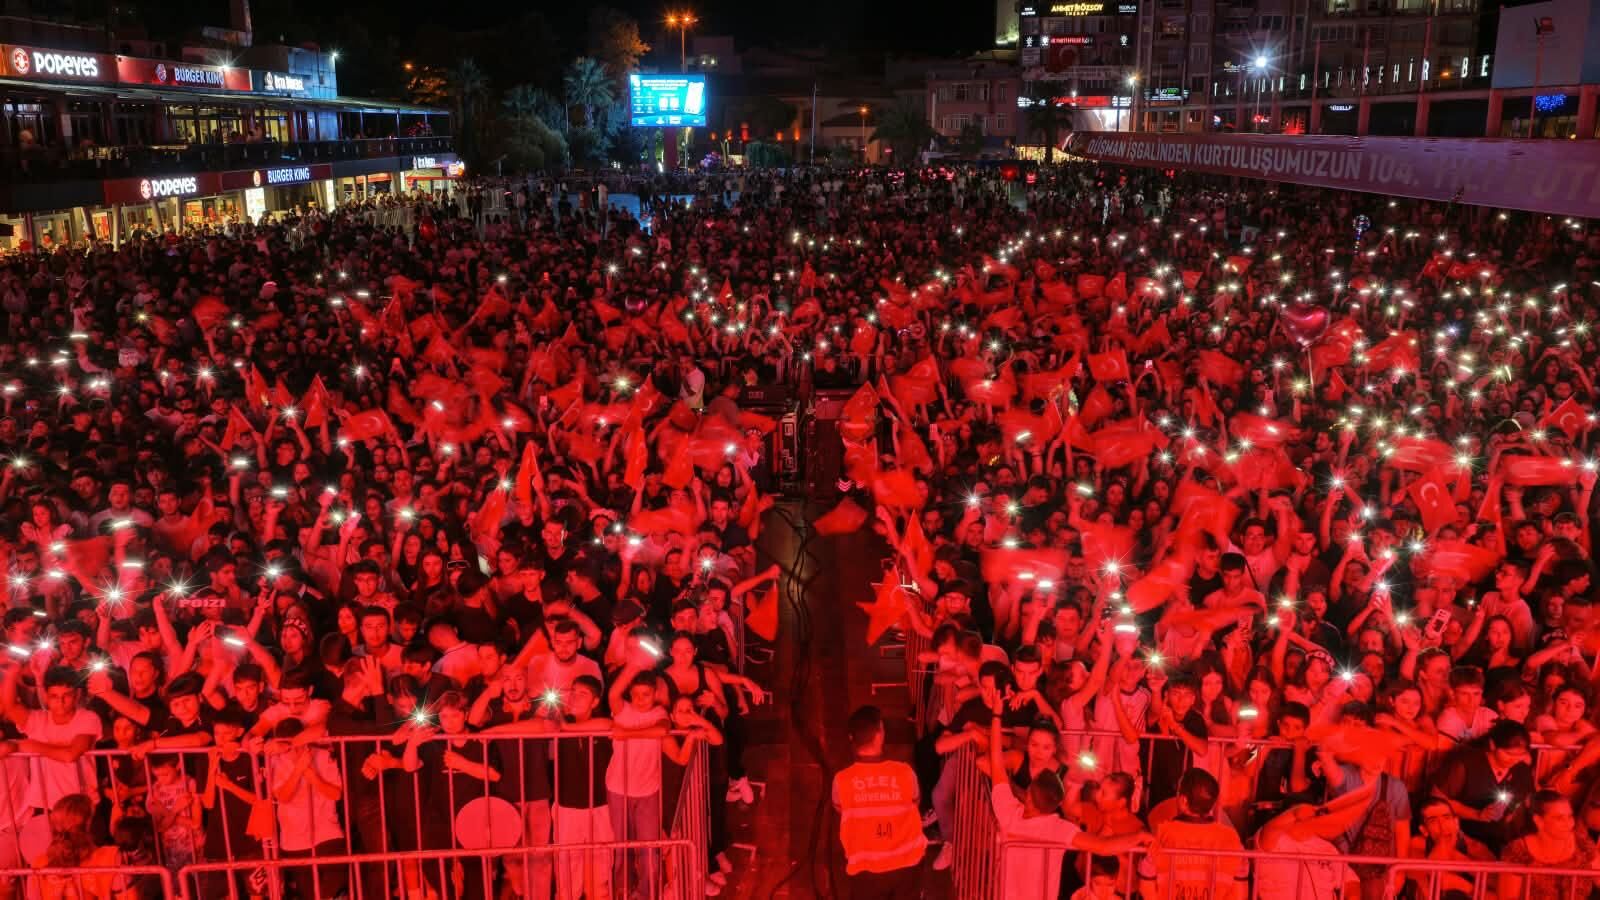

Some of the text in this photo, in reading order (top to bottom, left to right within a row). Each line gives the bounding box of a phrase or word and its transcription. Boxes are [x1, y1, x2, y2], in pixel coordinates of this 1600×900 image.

[33, 51, 98, 77] POPEYES
[174, 67, 225, 85] BURGER KING
[1087, 138, 1126, 158] DÜŞMAN
[1126, 138, 1193, 164] İŞGALİNDEN
[1195, 143, 1363, 179] KURTULUŞUMUZUN
[267, 167, 310, 184] BURGER KING
[152, 176, 198, 197] POPEYES
[852, 776, 900, 790] ÖZEL
